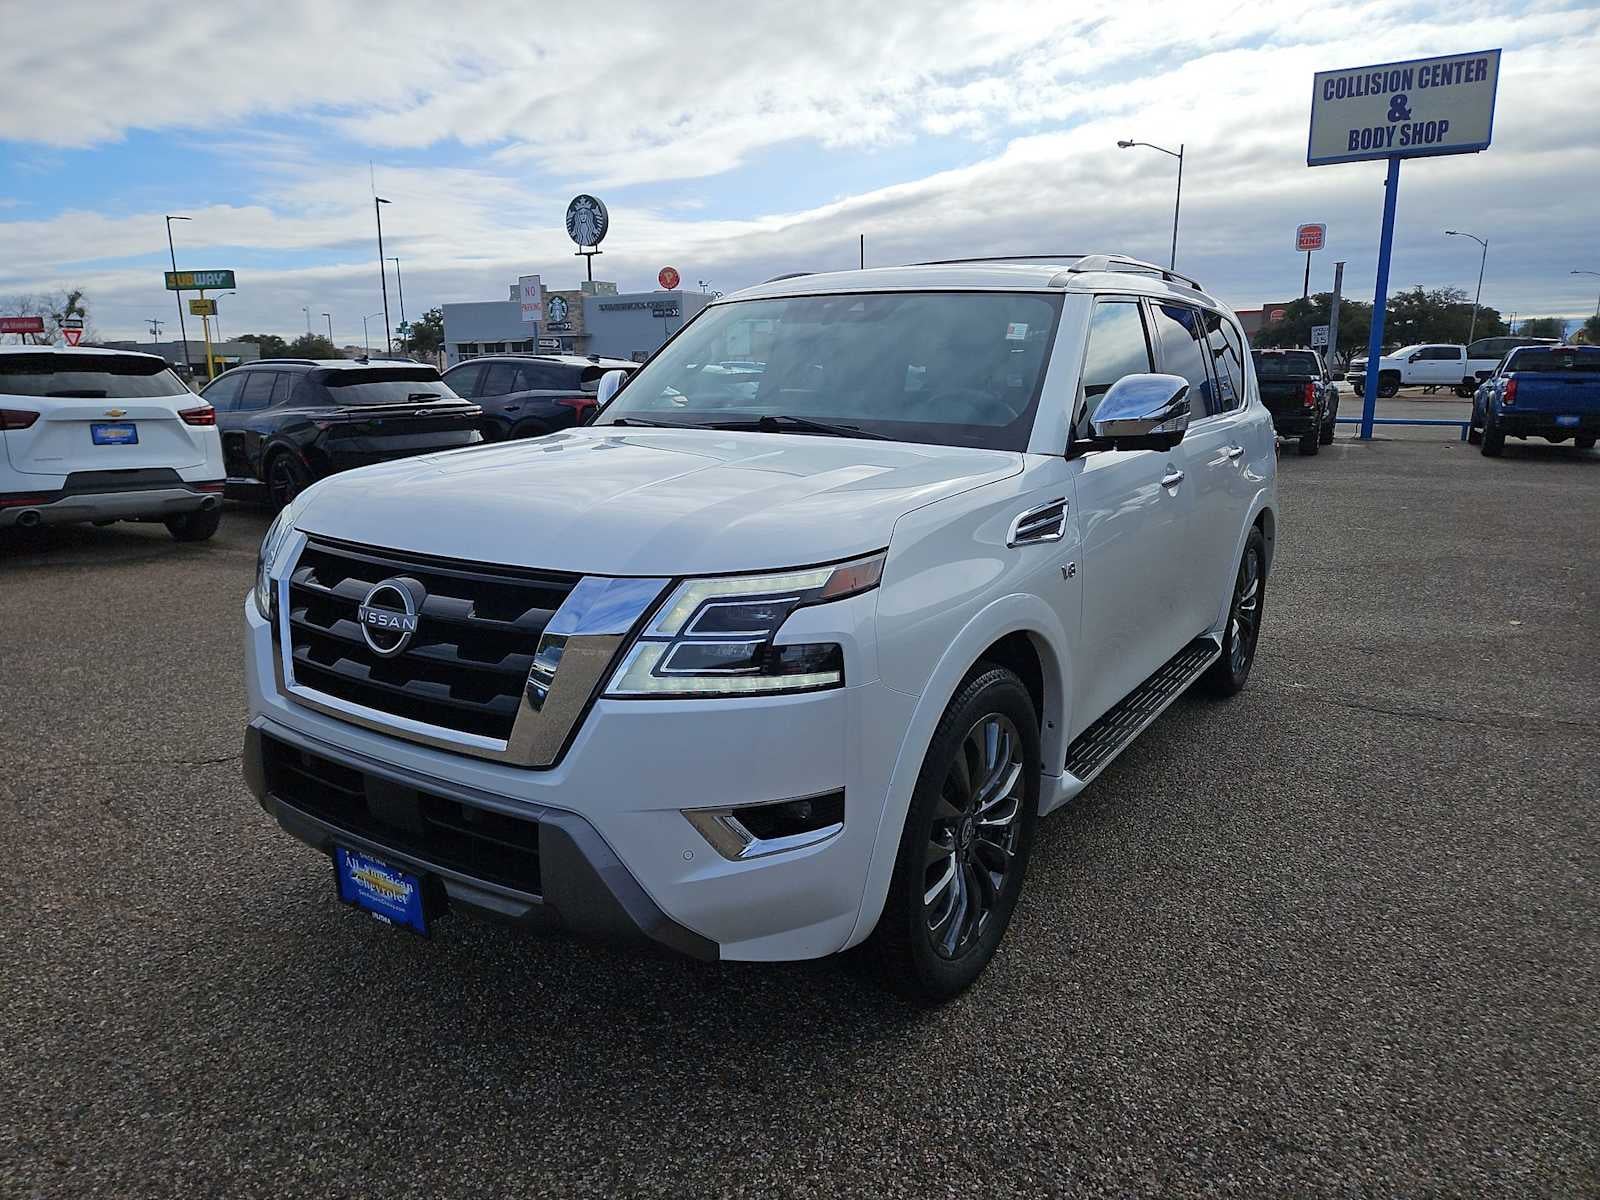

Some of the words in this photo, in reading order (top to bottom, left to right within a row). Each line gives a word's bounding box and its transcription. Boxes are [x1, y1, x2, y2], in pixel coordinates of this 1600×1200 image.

[1323, 68, 1413, 101] COLLISION
[1418, 58, 1488, 89] CENTER
[1387, 94, 1412, 122] &
[1348, 125, 1397, 151] BODY
[1399, 119, 1449, 146] SHOP
[167, 272, 225, 286] SUBWAY
[525, 286, 536, 297] NO
[521, 303, 543, 312] PARKING
[359, 604, 415, 631] NISSAN
